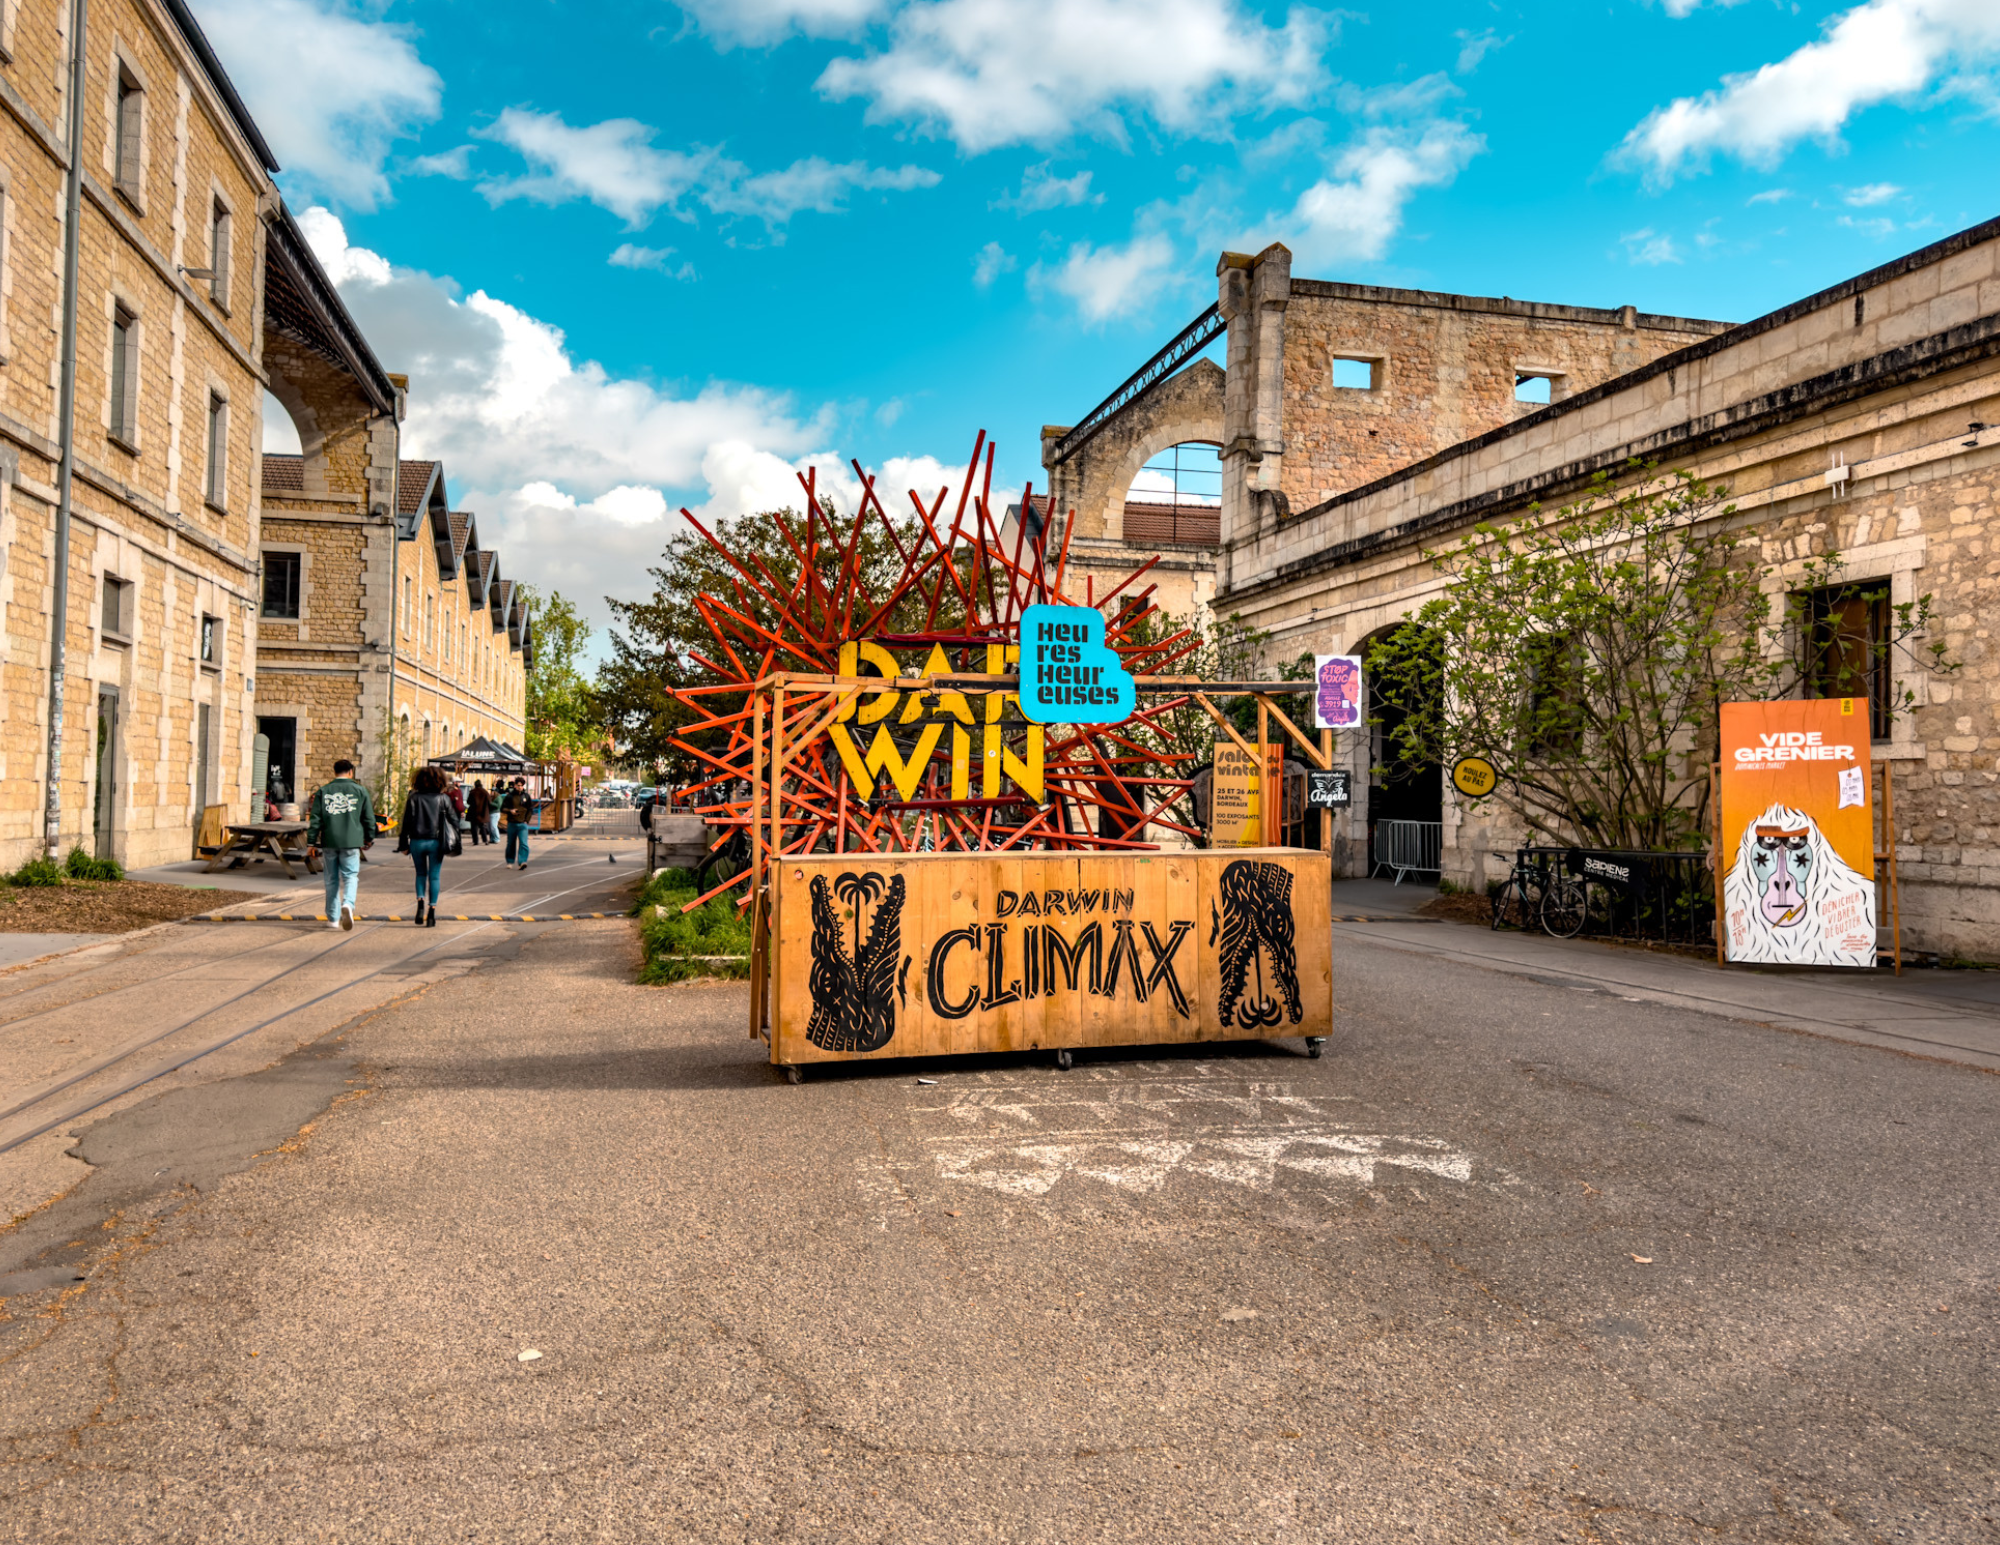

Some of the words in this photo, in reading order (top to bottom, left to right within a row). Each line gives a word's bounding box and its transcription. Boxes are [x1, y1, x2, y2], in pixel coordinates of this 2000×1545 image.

[1038, 622, 1088, 643] Heu
[1037, 644, 1081, 663] res
[1037, 664, 1105, 685] Heur
[1321, 675, 1349, 684] TOXIC
[1037, 686, 1119, 705] euses
[1324, 700, 1341, 708] 3919
[1759, 732, 1823, 747] VIDE
[1218, 749, 1252, 763] salo
[1734, 745, 1855, 762] GRENIER
[827, 721, 1045, 805] WIN
[1462, 775, 1471, 783] AU
[1472, 777, 1485, 787] PAS
[1463, 766, 1488, 779] ROULEZ
[1310, 787, 1348, 807] Angela
[1583, 866, 1605, 876] CENTRE
[996, 887, 1135, 918] DARWIN
[927, 920, 1195, 1020] CLIMAX
